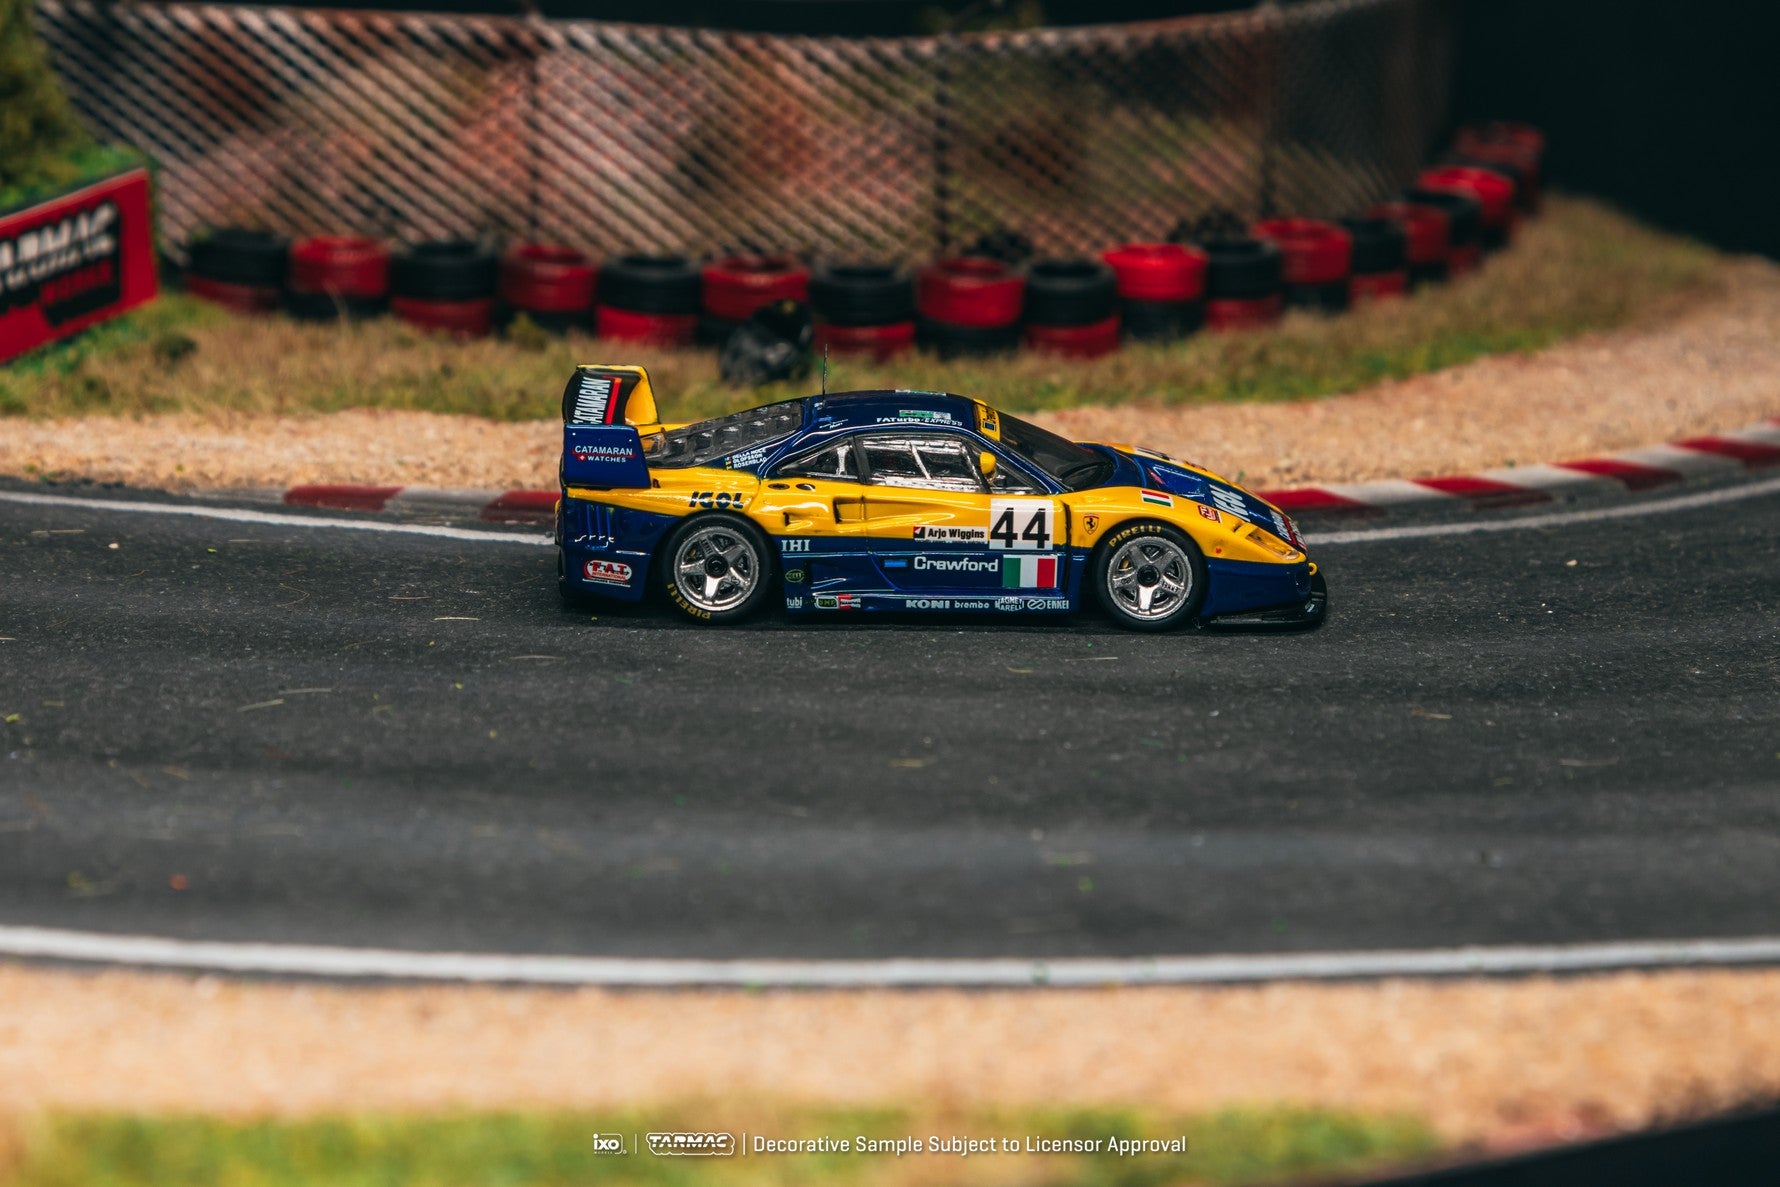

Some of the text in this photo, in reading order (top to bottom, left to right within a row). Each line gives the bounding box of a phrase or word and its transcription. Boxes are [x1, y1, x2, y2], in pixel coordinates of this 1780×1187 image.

[575, 445, 633, 456] CATAMARAN
[587, 455, 627, 463] WATCHES
[688, 491, 744, 509] IGOL
[928, 528, 985, 540] Arjo Wiggins
[990, 507, 1050, 549] 44
[1108, 524, 1162, 548] PIRELLI
[781, 539, 811, 552] IHI
[914, 556, 999, 572] Crawford
[666, 582, 712, 620] PIRELLI
[786, 596, 803, 606] tubi
[905, 599, 951, 609] KONI
[954, 600, 990, 609] brembo
[1046, 599, 1070, 610] ENKEI
